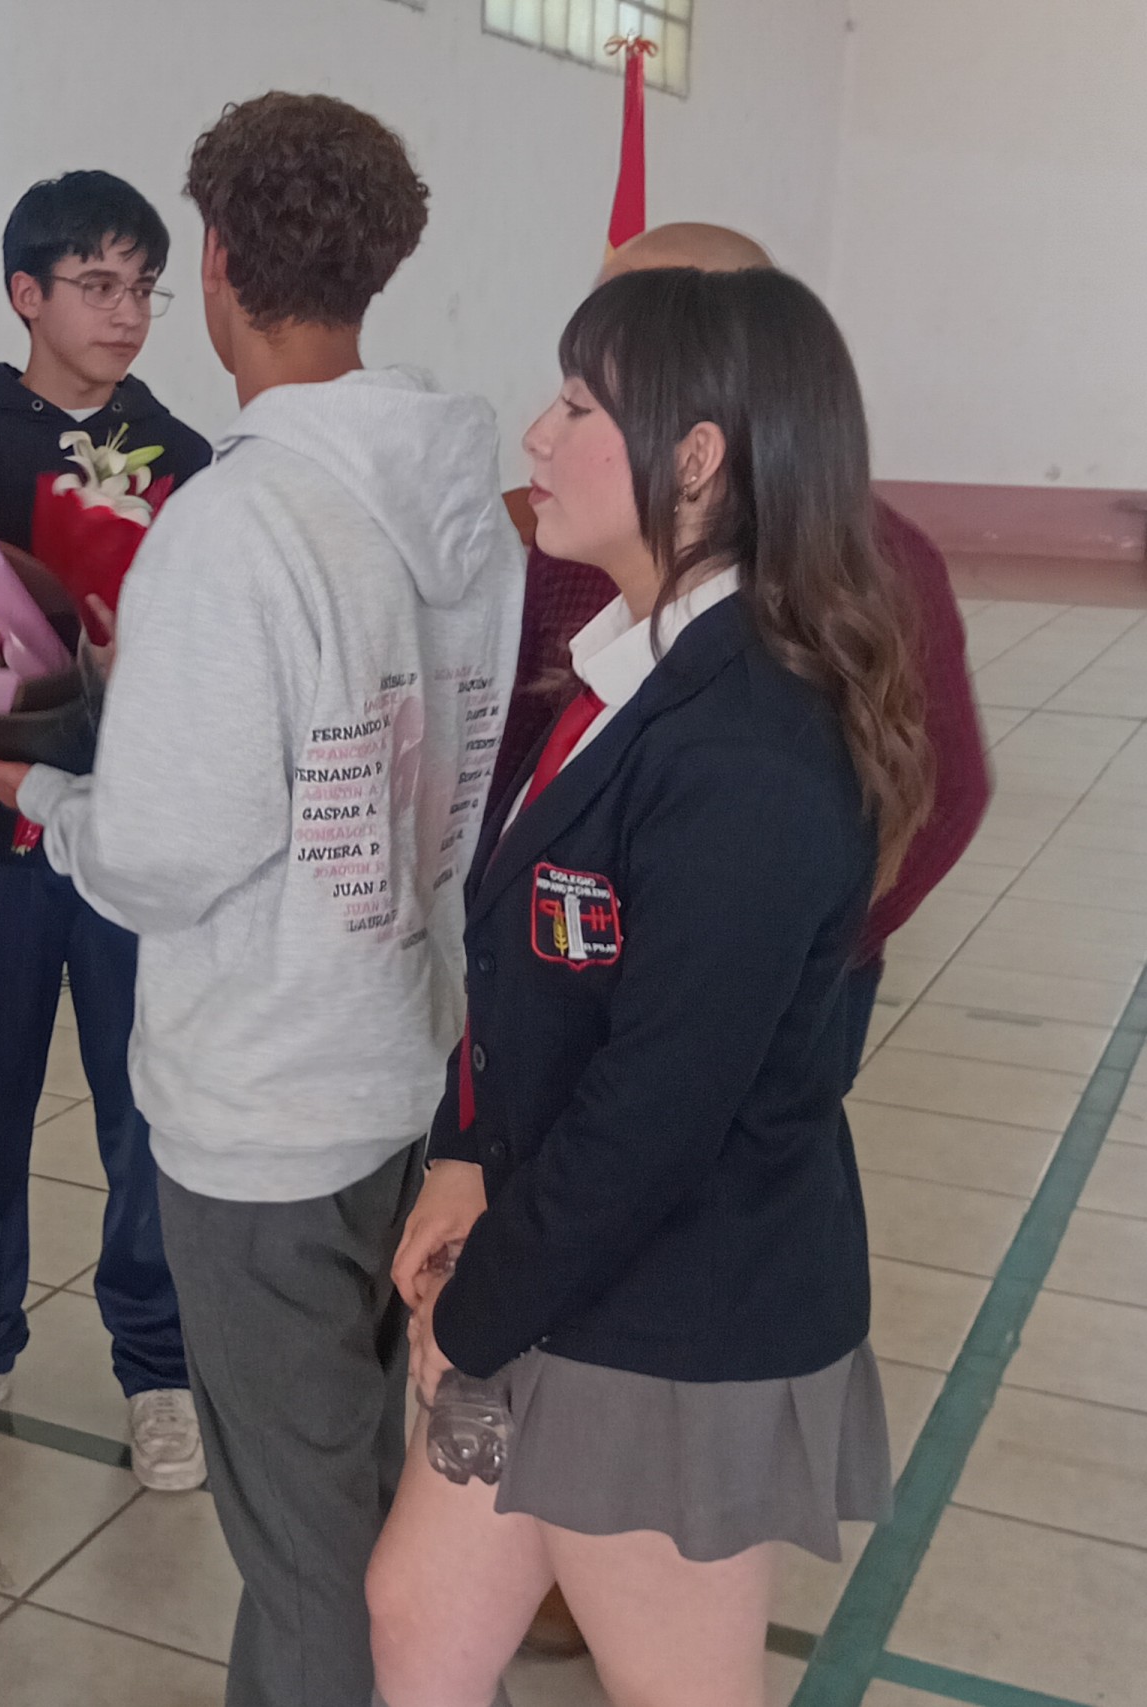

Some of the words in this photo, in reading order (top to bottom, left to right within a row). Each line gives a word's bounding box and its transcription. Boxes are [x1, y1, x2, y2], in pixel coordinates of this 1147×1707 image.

[312, 719, 382, 742] FERNANDO
[302, 805, 360, 820] GASPAR
[298, 843, 363, 862] JAVIERA
[550, 870, 597, 887] COLEGIO
[333, 882, 374, 898] JUAN
